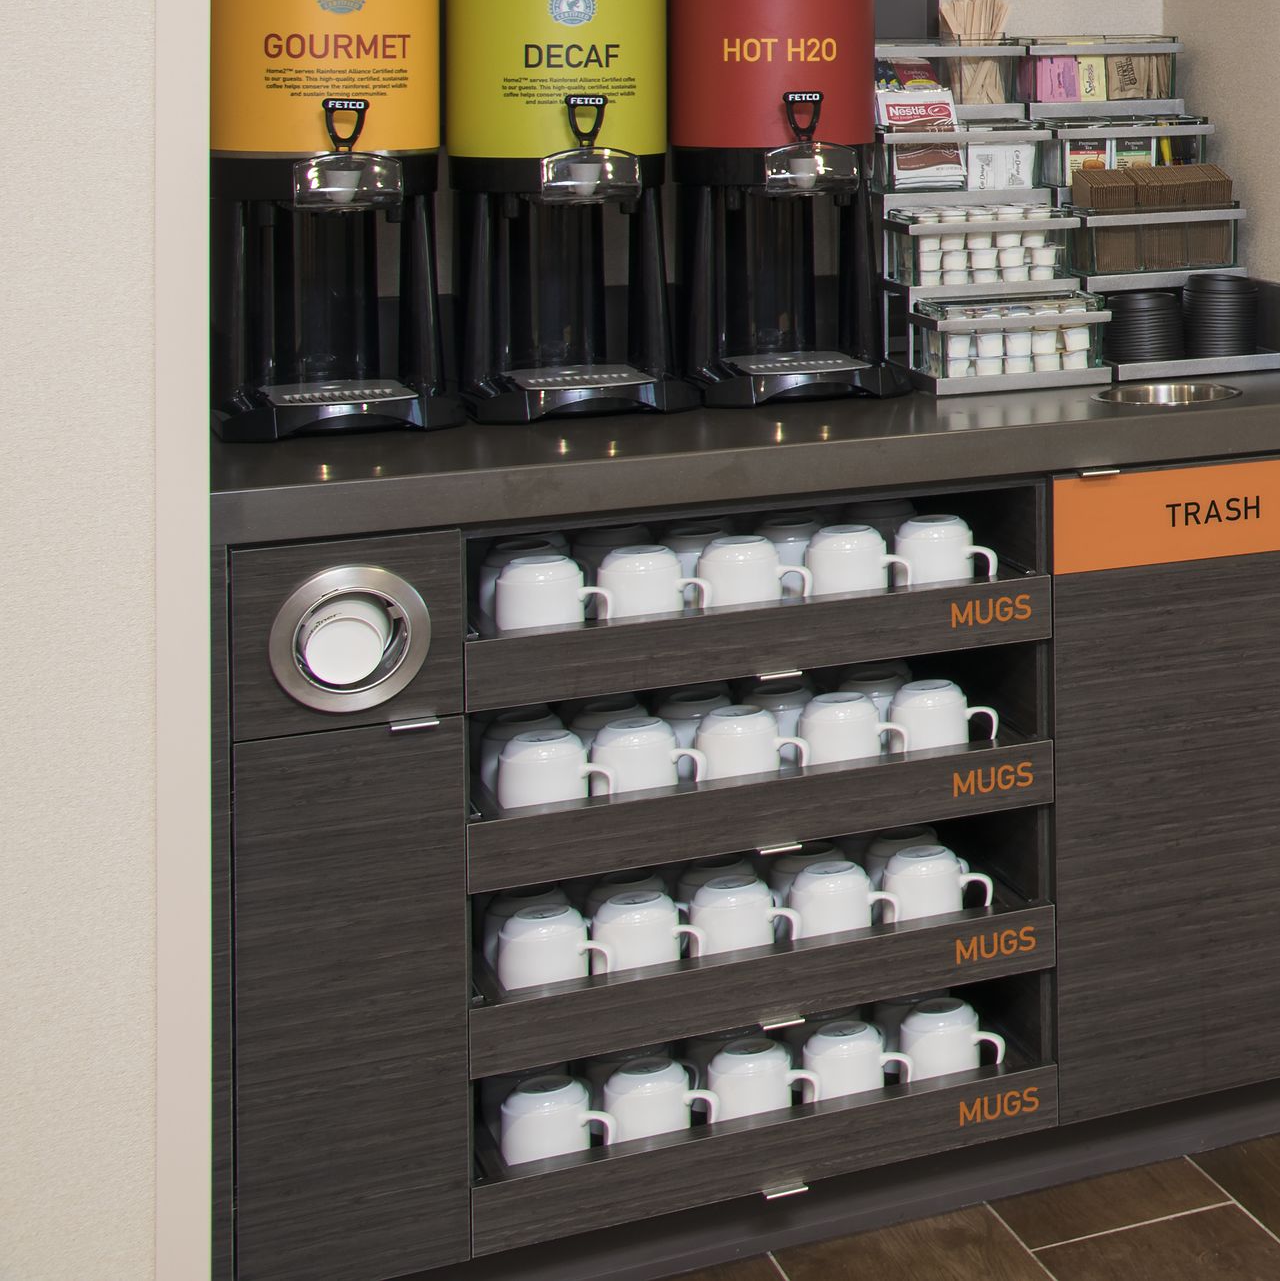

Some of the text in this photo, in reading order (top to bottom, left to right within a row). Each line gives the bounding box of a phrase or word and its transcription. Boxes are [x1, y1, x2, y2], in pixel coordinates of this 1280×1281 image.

[264, 33, 411, 60] GOURMET
[524, 44, 620, 68] DECAF
[723, 38, 778, 62] HOT
[328, 100, 365, 109] FETCO
[570, 97, 604, 105] FETCO
[788, 93, 820, 101] FETCO
[1165, 494, 1261, 529] TRASH
[950, 593, 1033, 630] MUGS
[952, 761, 1034, 798] MUGS
[955, 925, 1037, 965] MUGS
[958, 1086, 1041, 1127] MUGS
